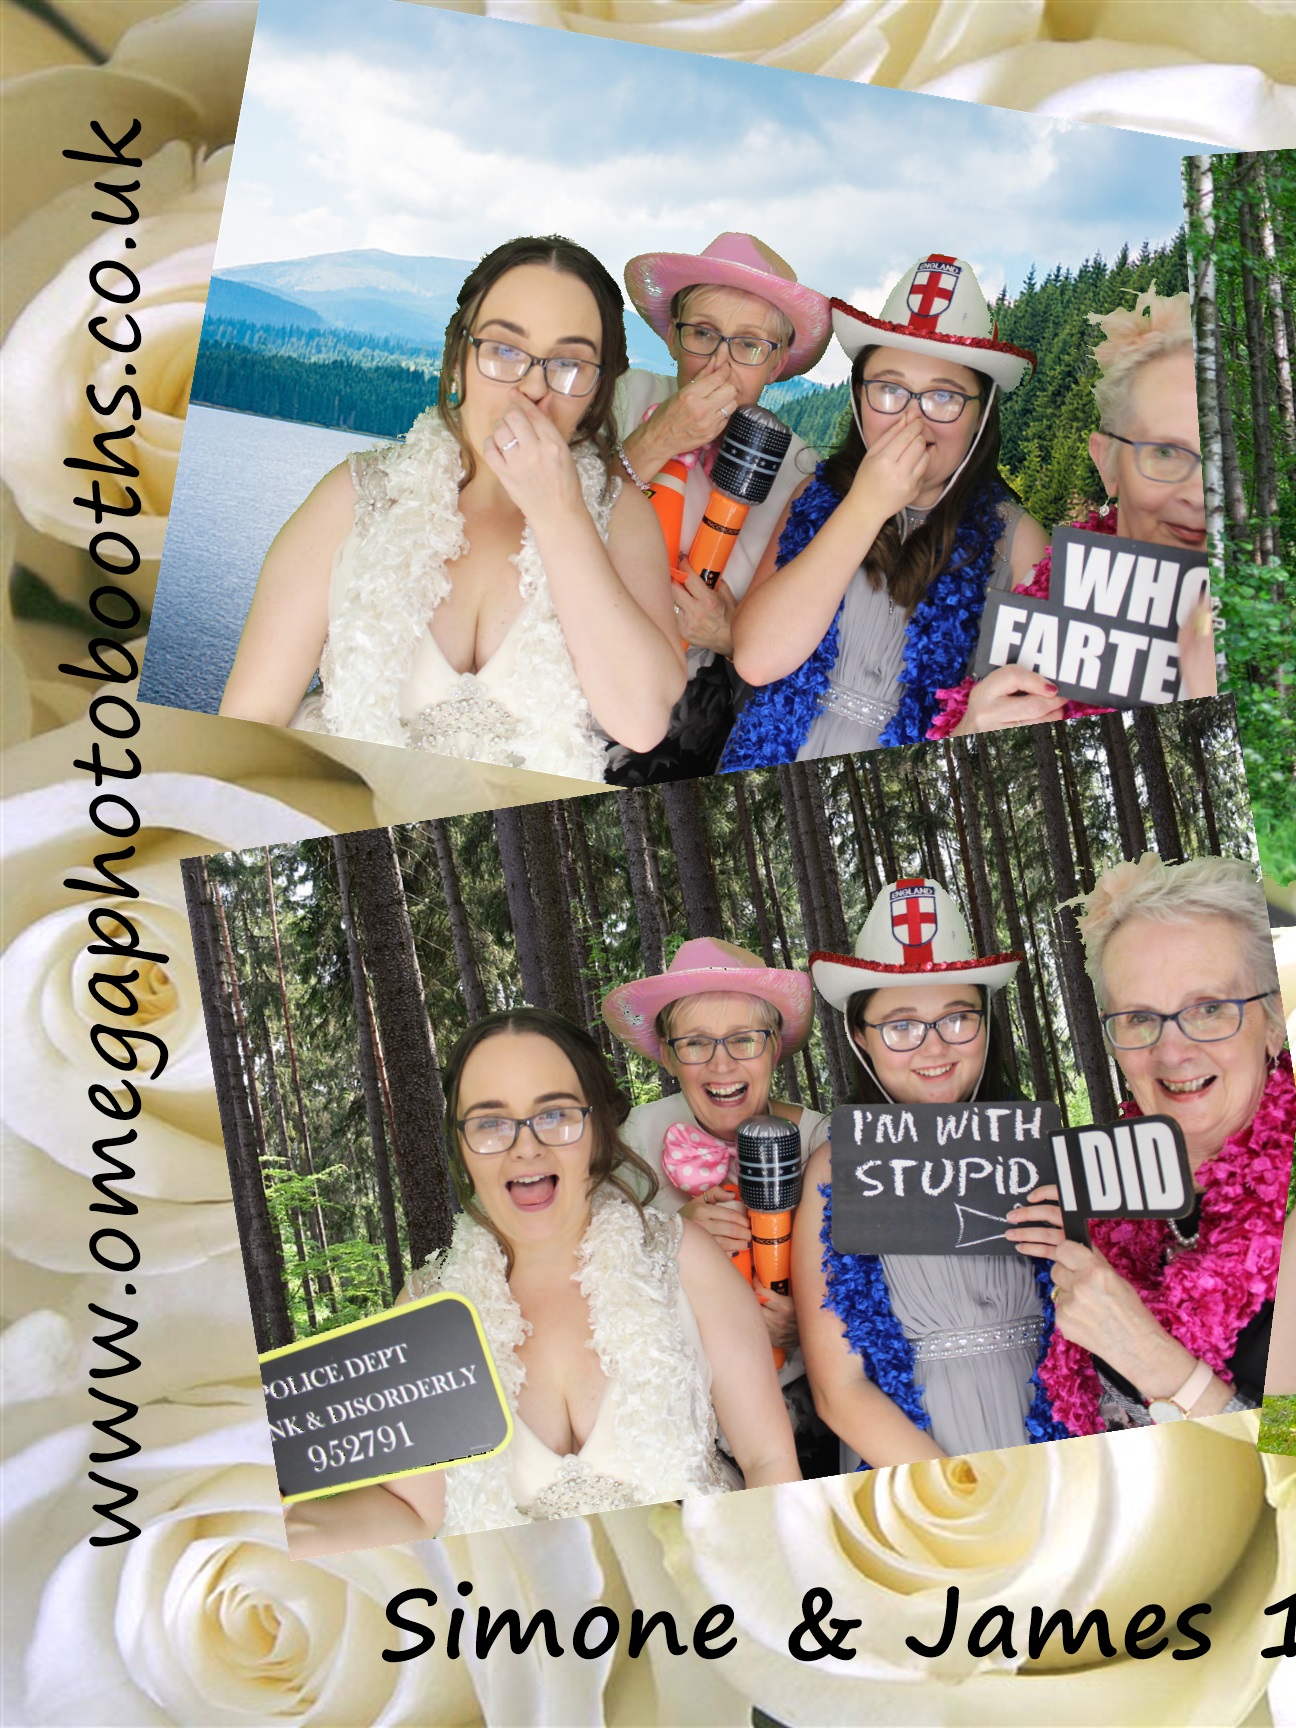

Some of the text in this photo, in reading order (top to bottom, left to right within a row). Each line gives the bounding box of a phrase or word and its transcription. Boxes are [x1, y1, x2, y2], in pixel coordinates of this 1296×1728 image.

[919, 261, 960, 274] ENGLAND
[891, 886, 934, 899] ENGLAND
[853, 1108, 919, 1146] I'M
[1051, 1121, 1186, 1212] I DID
[344, 1342, 409, 1379] DEPT
[305, 1410, 327, 1431] &
[326, 1363, 478, 1425] DISORDERLY
[306, 1420, 415, 1474] 952791
